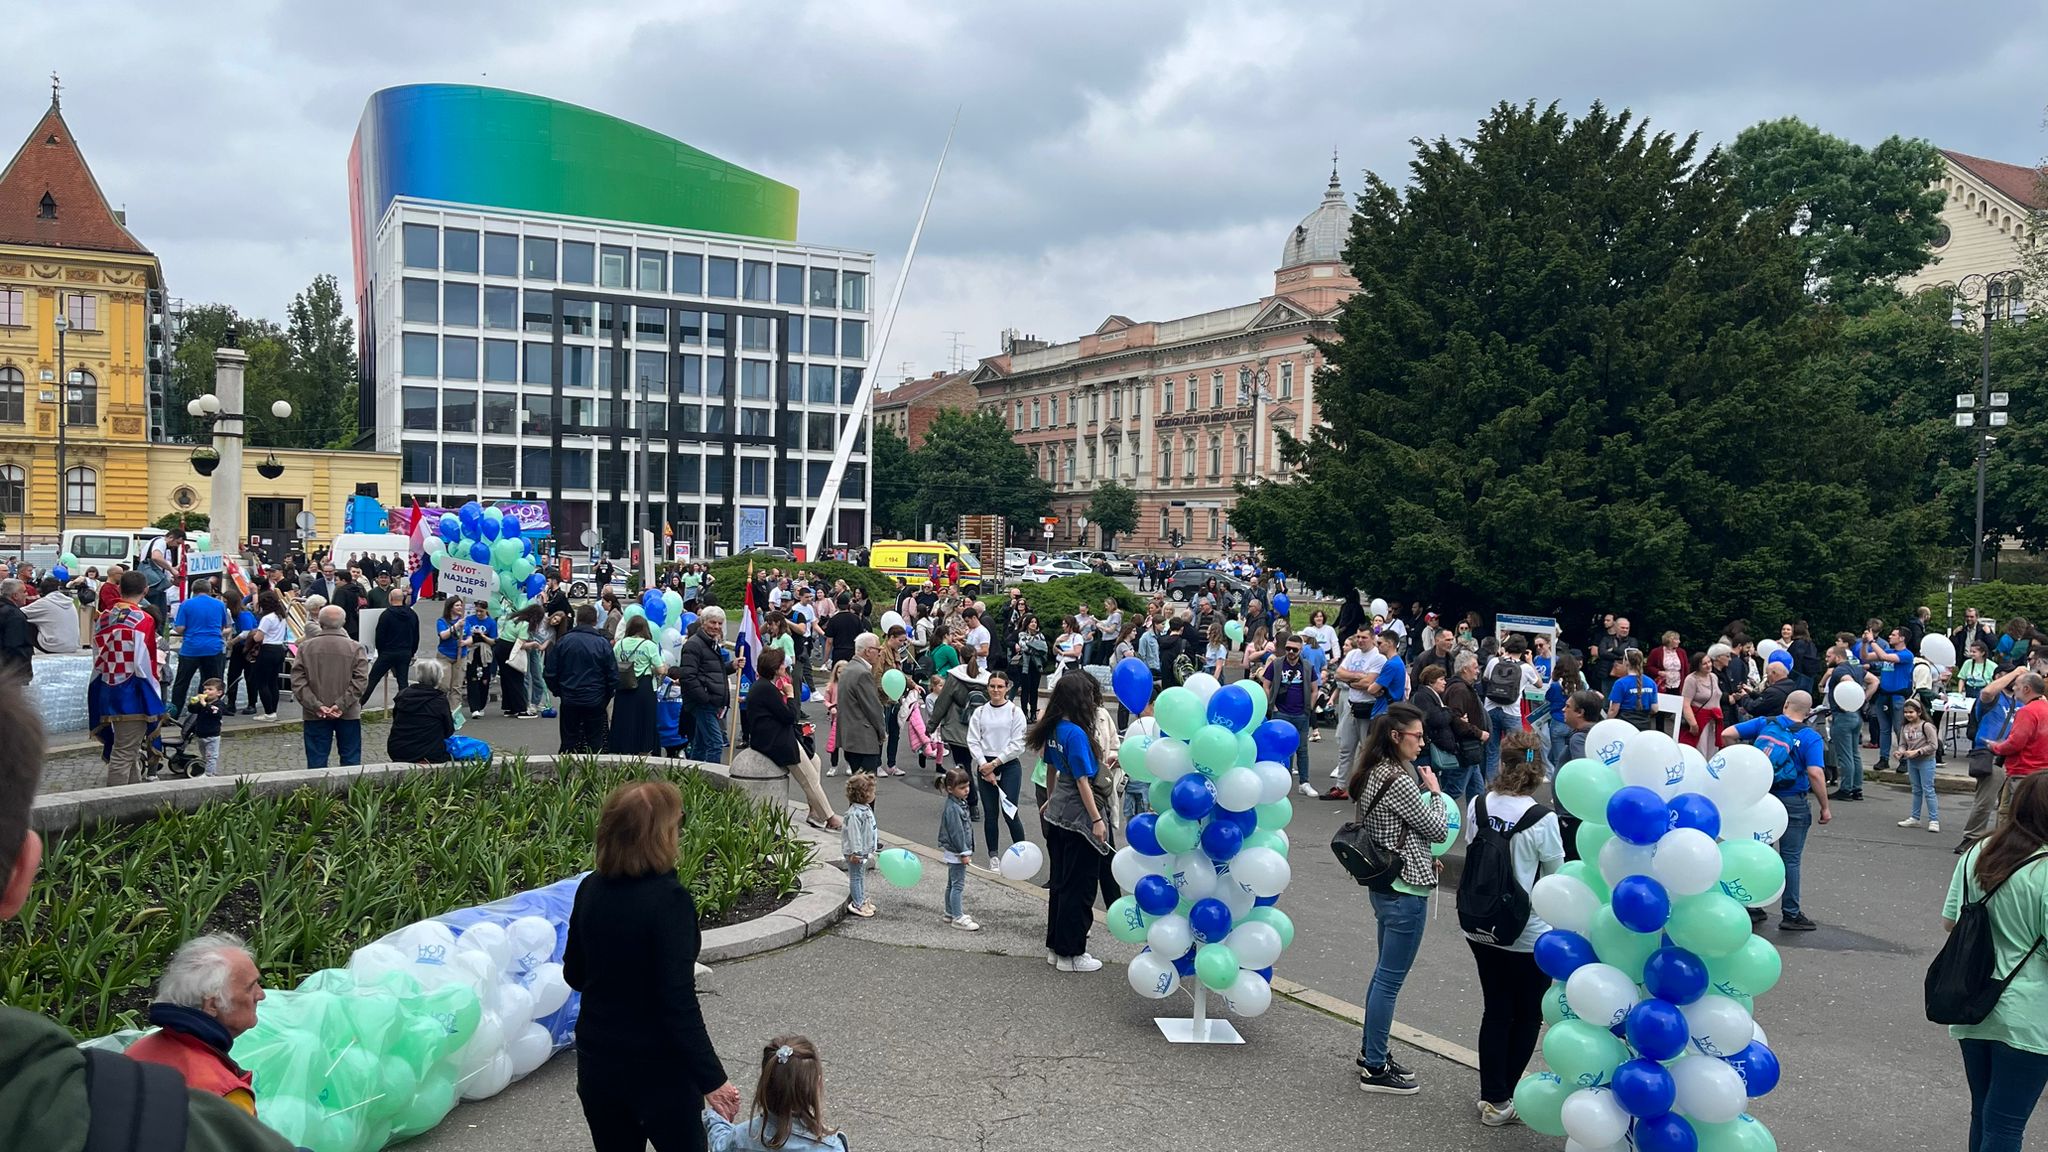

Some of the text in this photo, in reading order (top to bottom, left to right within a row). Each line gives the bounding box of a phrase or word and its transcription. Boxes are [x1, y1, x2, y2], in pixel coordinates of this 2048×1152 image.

[190, 554, 222, 571] ZA ŽIVOT
[452, 562, 477, 574] ŽIVOT
[443, 572, 488, 588] NAJLJEPŠI
[455, 585, 474, 595] DAR
[1596, 740, 1624, 758] HOD
[1729, 878, 1752, 902] HOD
[417, 944, 446, 957] HOD
